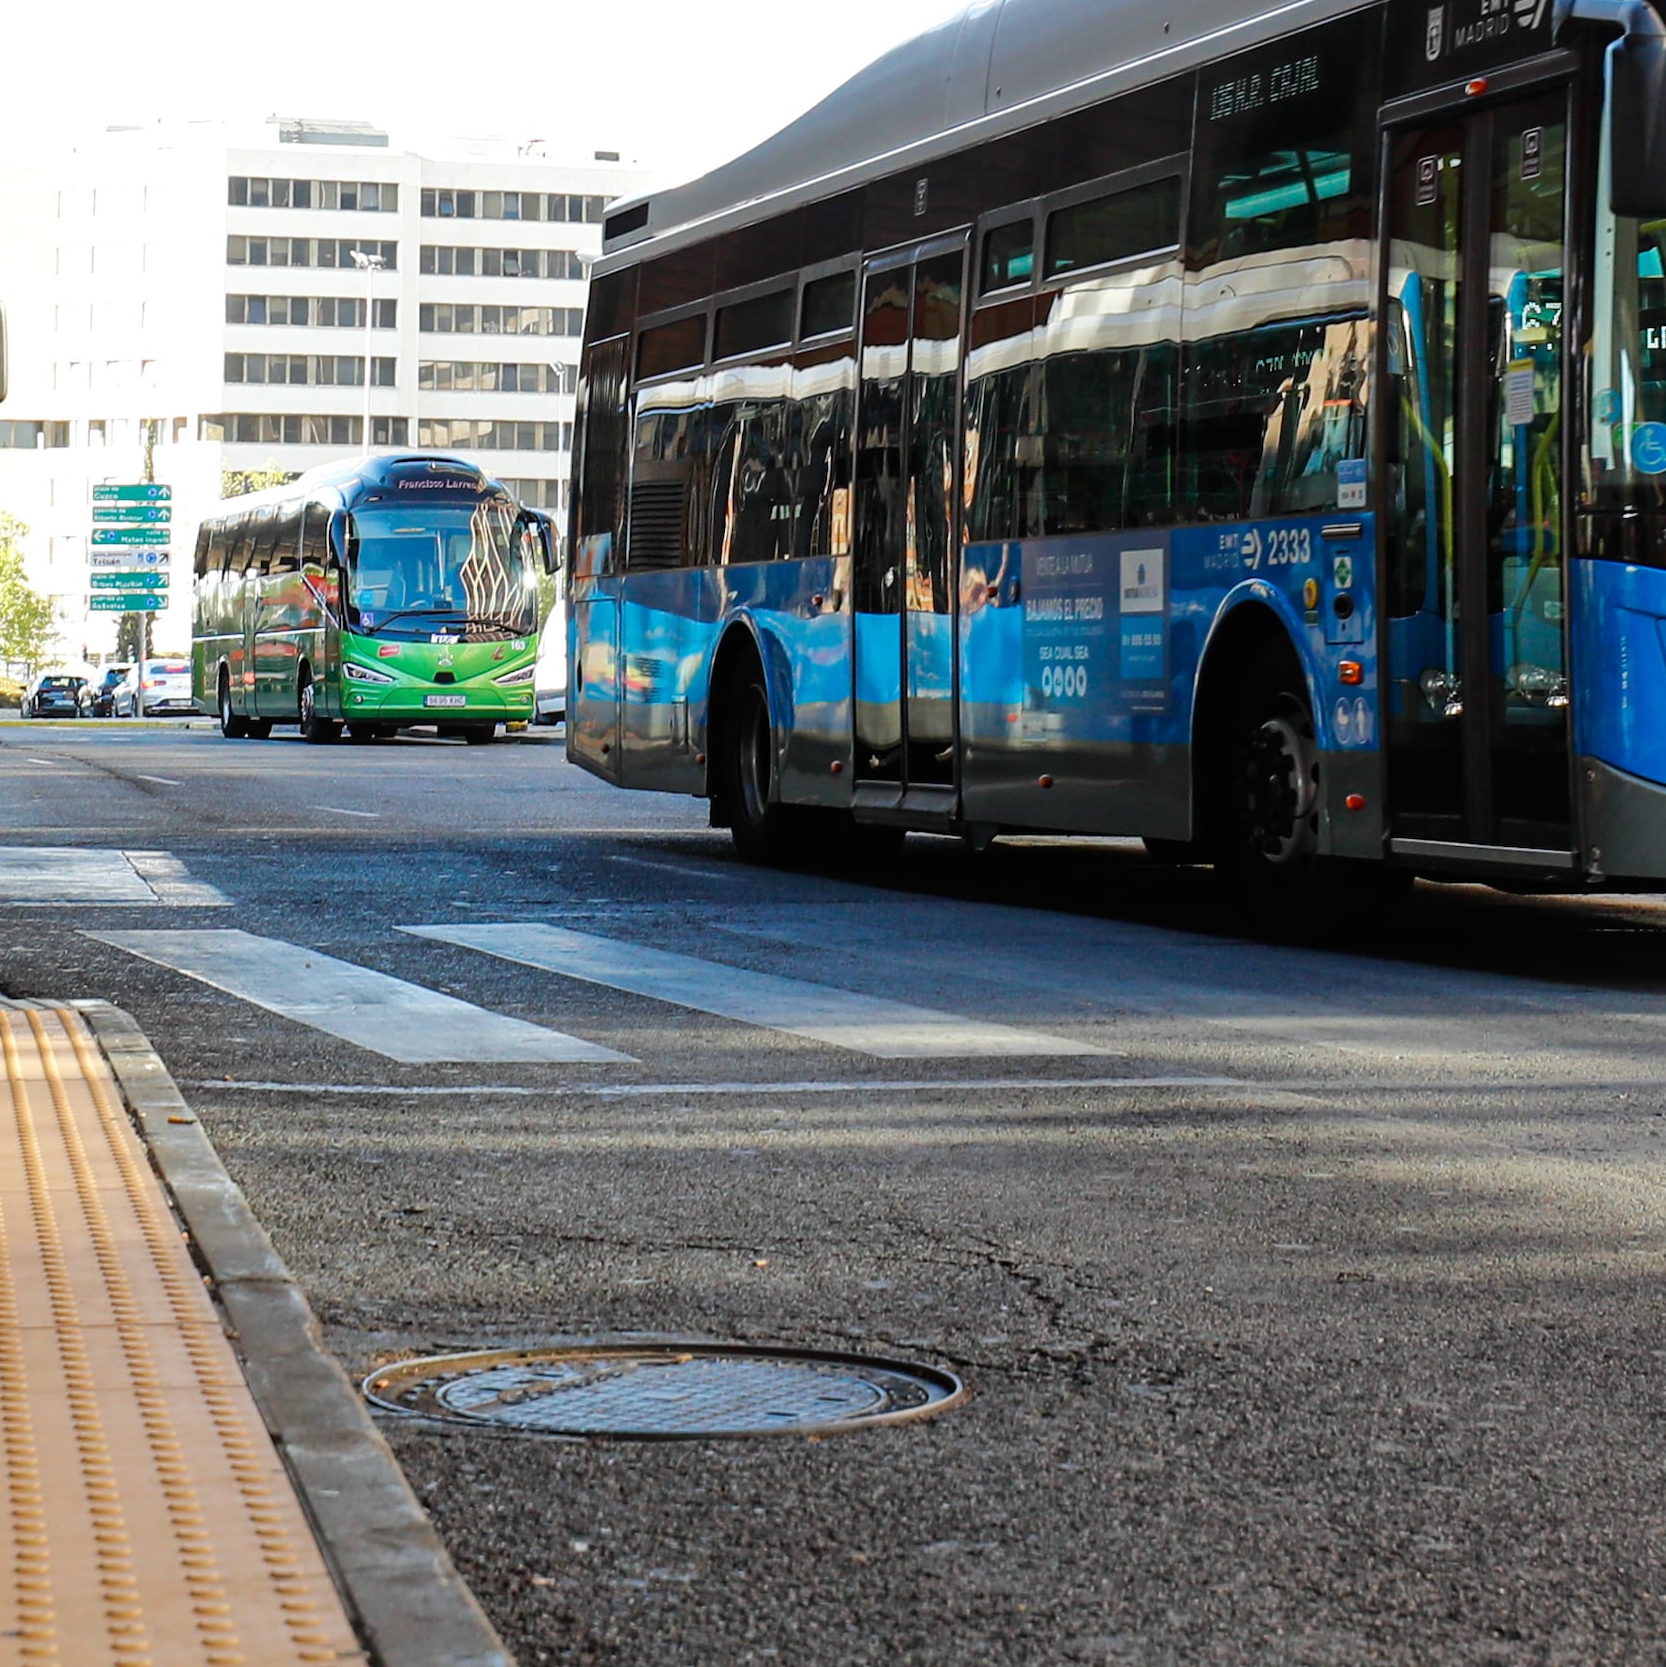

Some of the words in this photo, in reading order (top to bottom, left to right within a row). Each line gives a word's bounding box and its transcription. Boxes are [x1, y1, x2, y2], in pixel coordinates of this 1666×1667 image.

[1454, 13, 1509, 48] MADRID
[398, 479, 445, 490] Francisco
[1268, 528, 1311, 565] 2333
[1026, 598, 1063, 621] BAJAMOS
[1064, 598, 1074, 620] EL
[1075, 596, 1103, 620] PRECIO
[1039, 645, 1053, 660] SEA
[1054, 645, 1073, 660] CUAL
[1074, 644, 1089, 660] SEA
